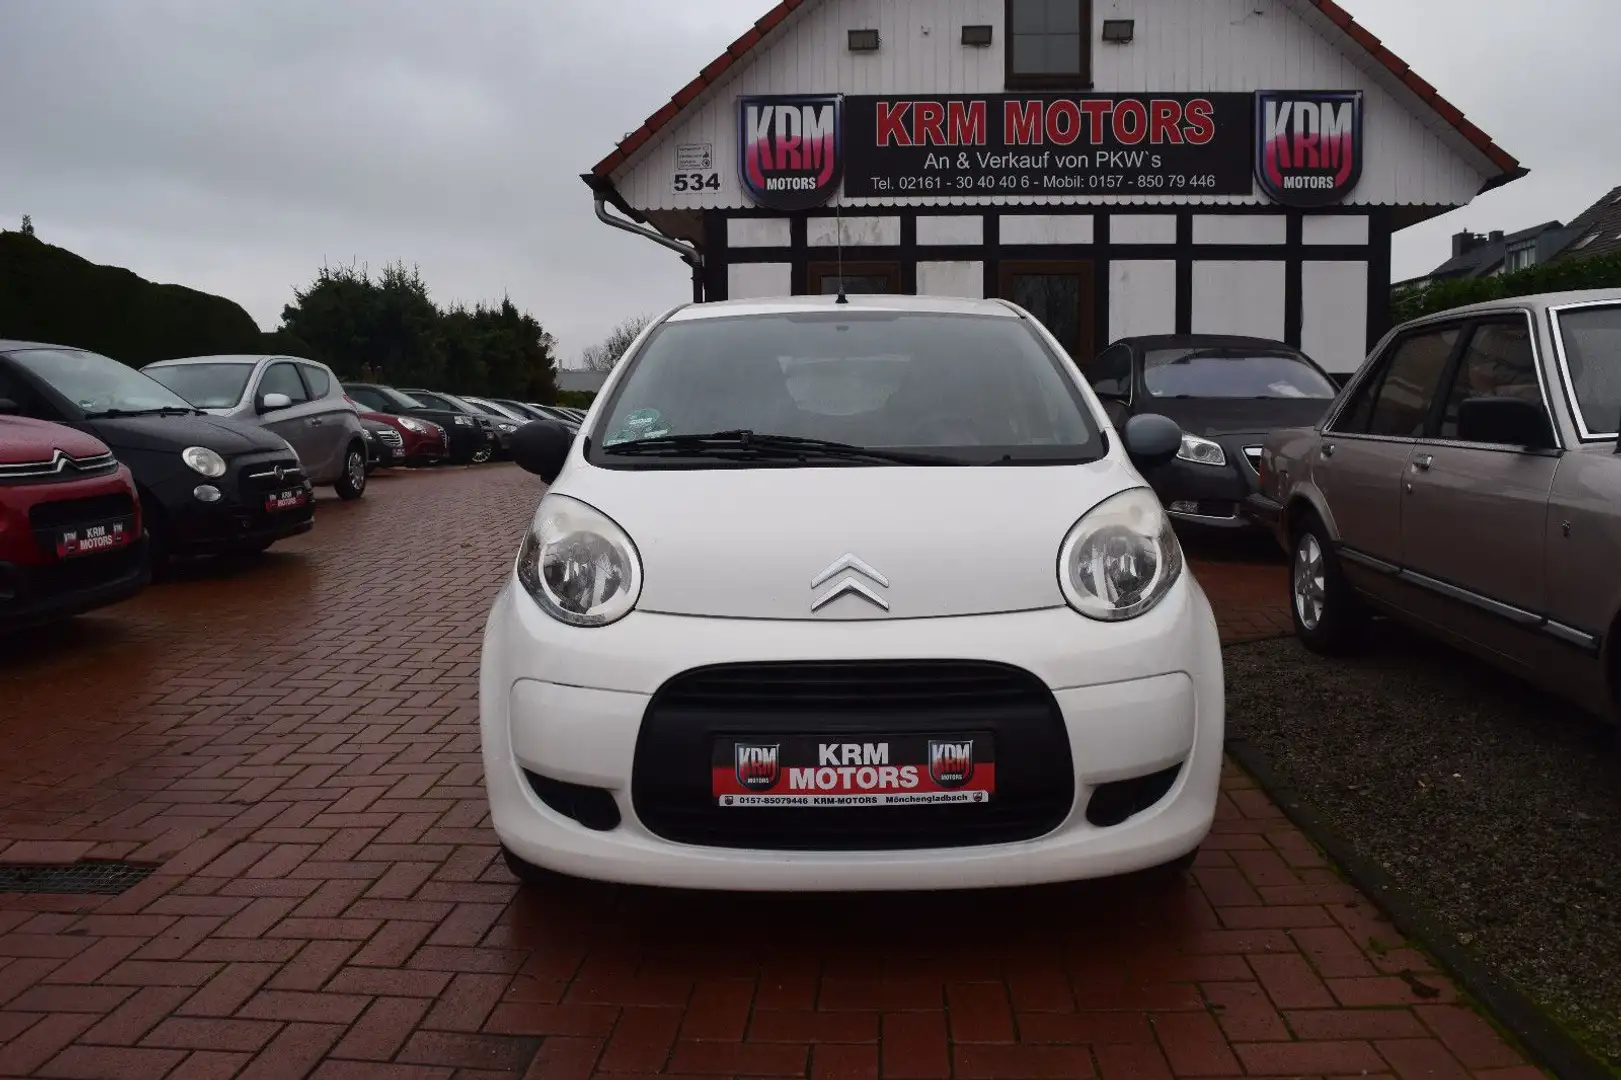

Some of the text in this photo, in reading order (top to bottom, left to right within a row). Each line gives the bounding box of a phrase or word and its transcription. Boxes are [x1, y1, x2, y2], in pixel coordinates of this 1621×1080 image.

[875, 98, 1216, 146] KRM MOTORS
[747, 105, 835, 171] KRM
[1265, 101, 1353, 169] KRM
[923, 151, 950, 170] An
[956, 152, 971, 169] &
[976, 151, 1051, 169] Verkauf
[1055, 154, 1089, 169] von
[674, 172, 721, 192] 534
[766, 177, 817, 190] MOTORS
[870, 176, 895, 190] Tel.
[899, 176, 942, 190] 02161
[956, 175, 974, 189] 30
[977, 175, 995, 189] 40
[999, 175, 1017, 189] 40
[1020, 175, 1031, 188] 6
[1043, 175, 1085, 188] Mobil:
[1088, 175, 1124, 188] 0157
[1137, 175, 1164, 188] 850
[1168, 175, 1186, 188] 79
[1189, 175, 1216, 188] 446
[1283, 175, 1335, 190] MOTORS
[86, 525, 106, 538] KRM
[80, 535, 114, 551] MOTORS
[818, 743, 889, 766] KRM
[789, 765, 919, 790] MOTORS
[739, 793, 968, 805] 0157-85079446 KRM-MOTORS Mönchengladbach
